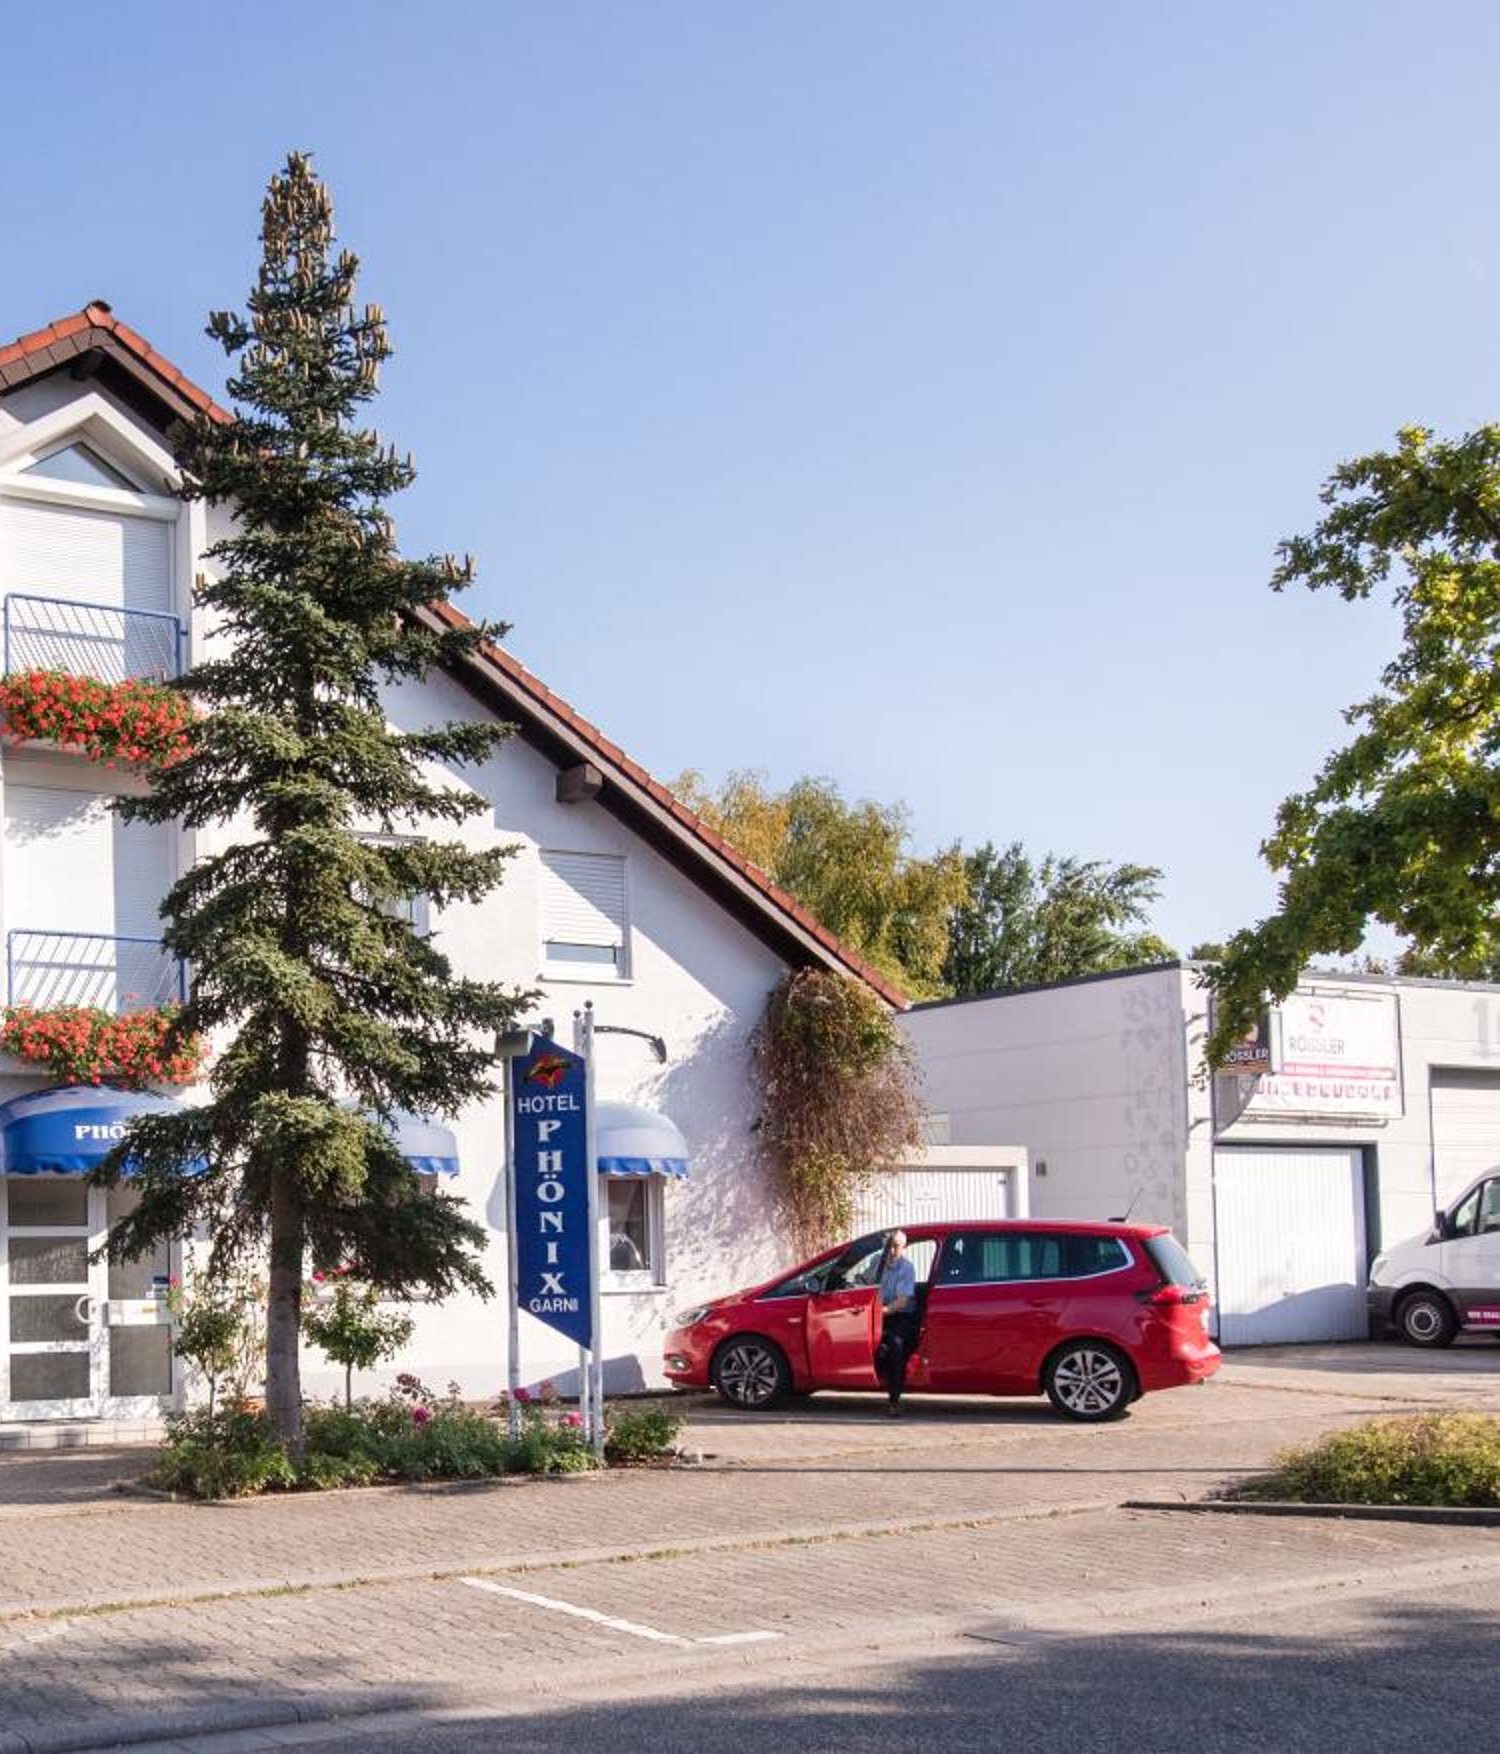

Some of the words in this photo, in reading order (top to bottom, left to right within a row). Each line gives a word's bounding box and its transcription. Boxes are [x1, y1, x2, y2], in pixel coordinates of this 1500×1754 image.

[518, 1095, 580, 1113] HOTEL
[536, 1119, 566, 1294] PHÖNIX
[530, 1298, 579, 1313] GARNI
